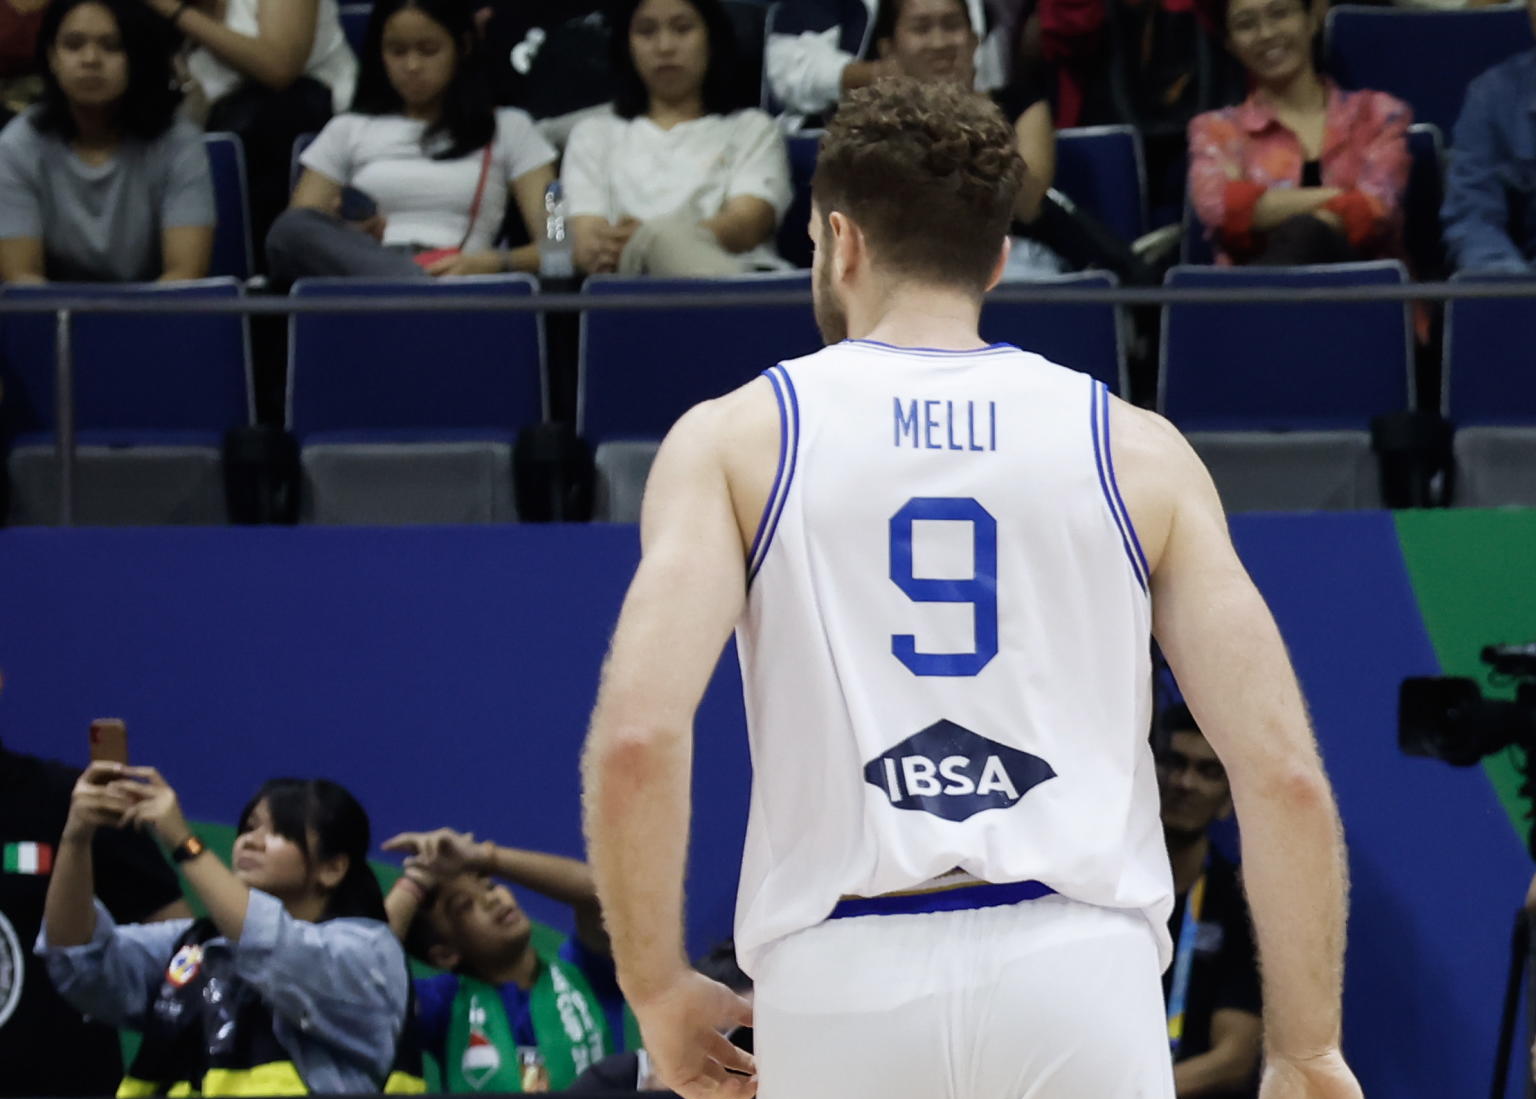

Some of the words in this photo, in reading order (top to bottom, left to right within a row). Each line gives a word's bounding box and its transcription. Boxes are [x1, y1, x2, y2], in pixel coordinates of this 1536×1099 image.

[893, 397, 996, 451] MELLI
[889, 497, 998, 677] 9
[882, 755, 1020, 802] IBSA
